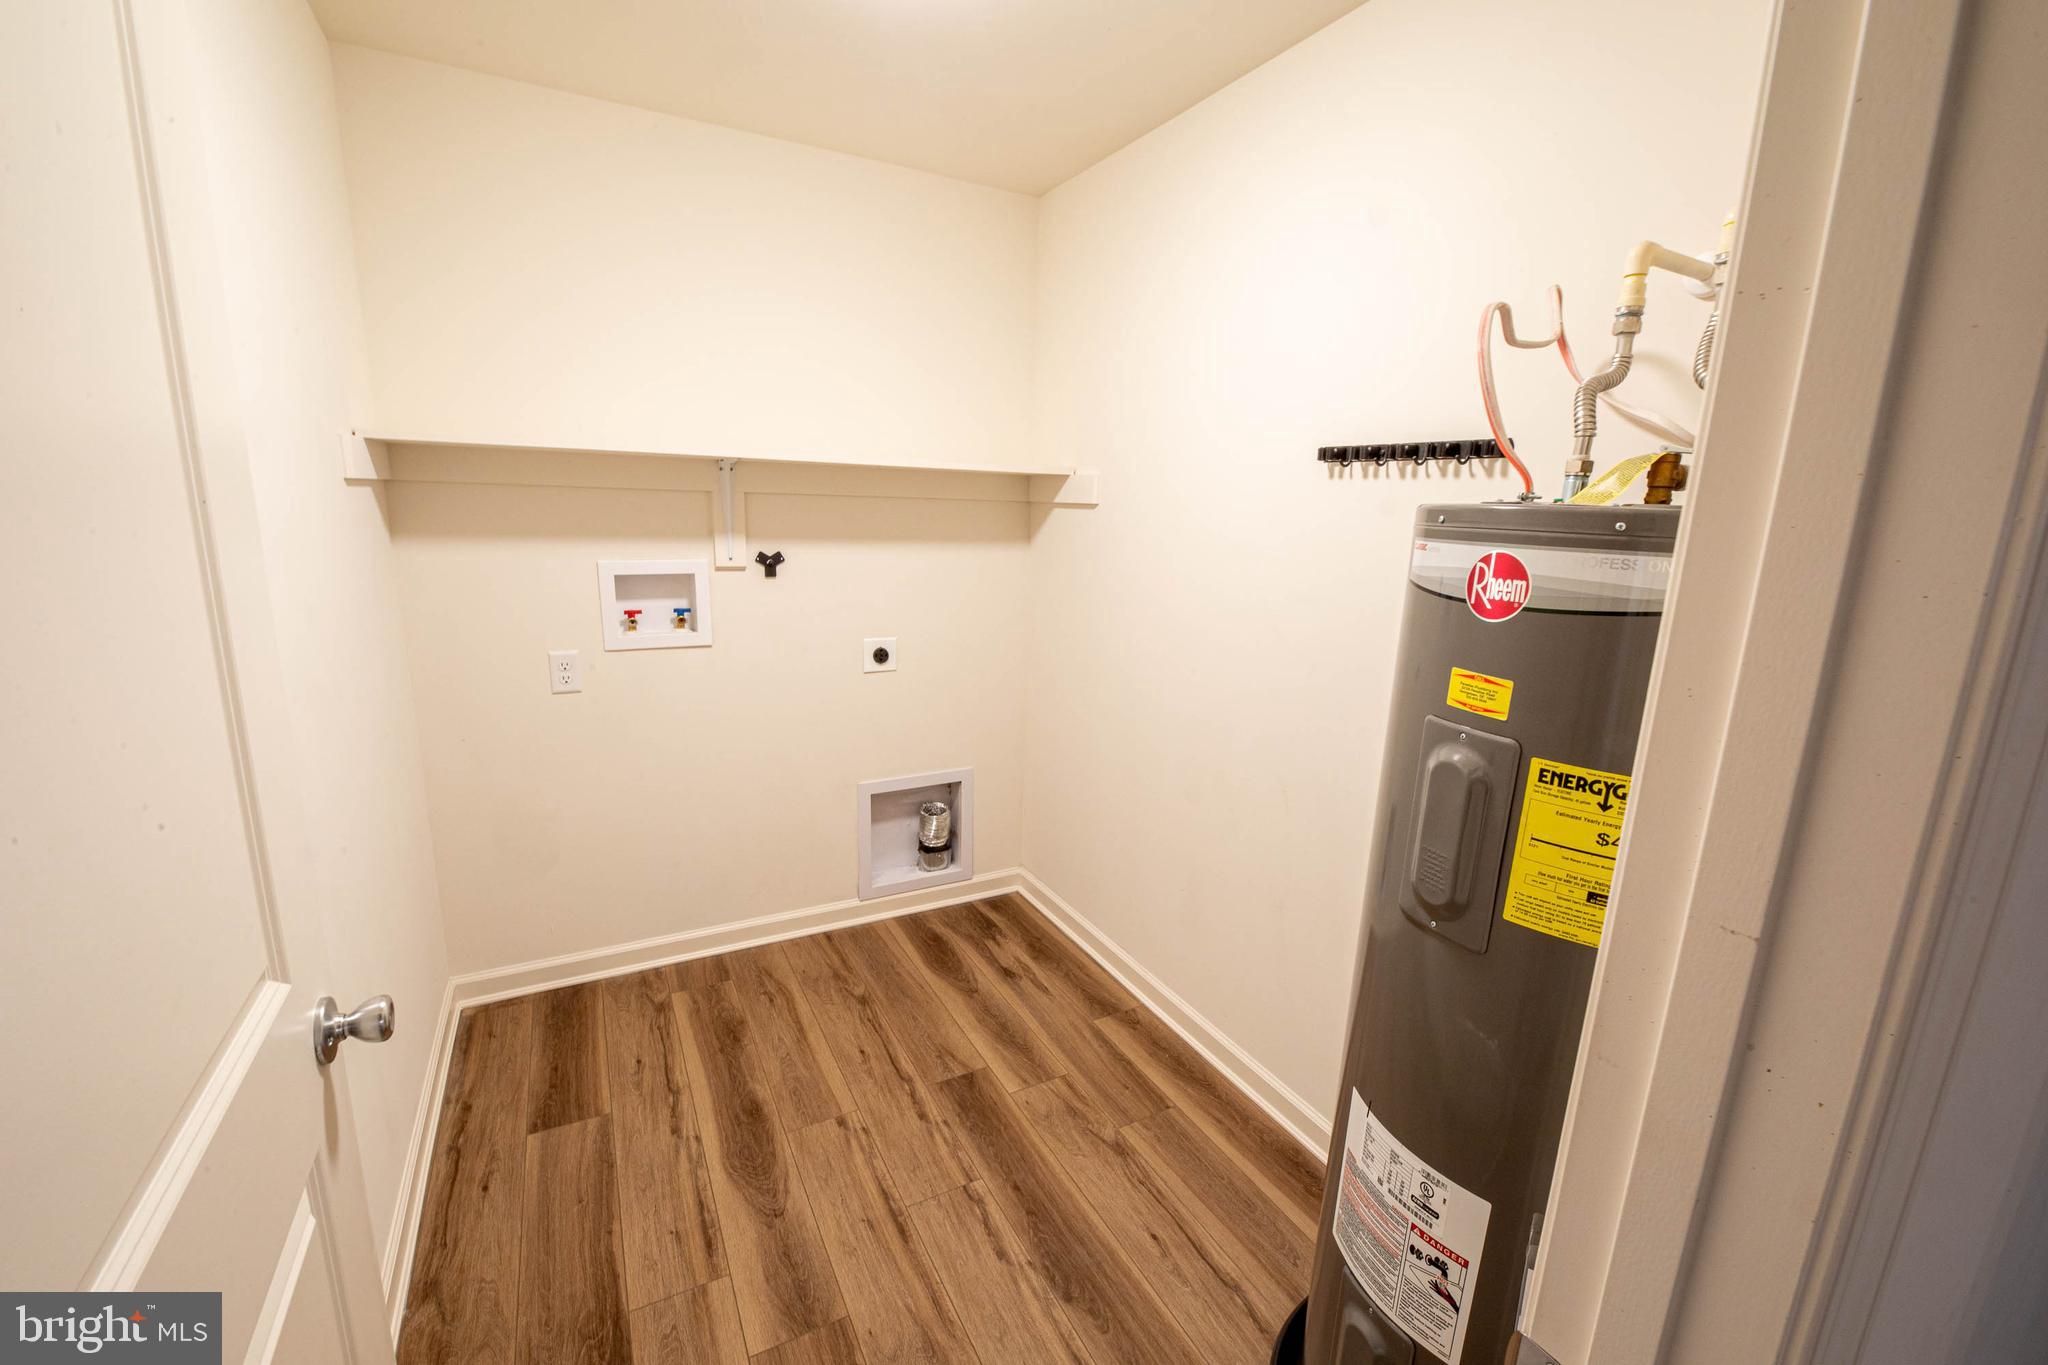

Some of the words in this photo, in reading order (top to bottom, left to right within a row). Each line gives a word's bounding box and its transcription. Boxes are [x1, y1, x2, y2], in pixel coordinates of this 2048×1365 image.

[1470, 550, 1527, 609] Rheem
[1556, 810, 1582, 822] Estimated
[1584, 816, 1600, 826] Yearly
[1423, 1233, 1465, 1266] DANGER
